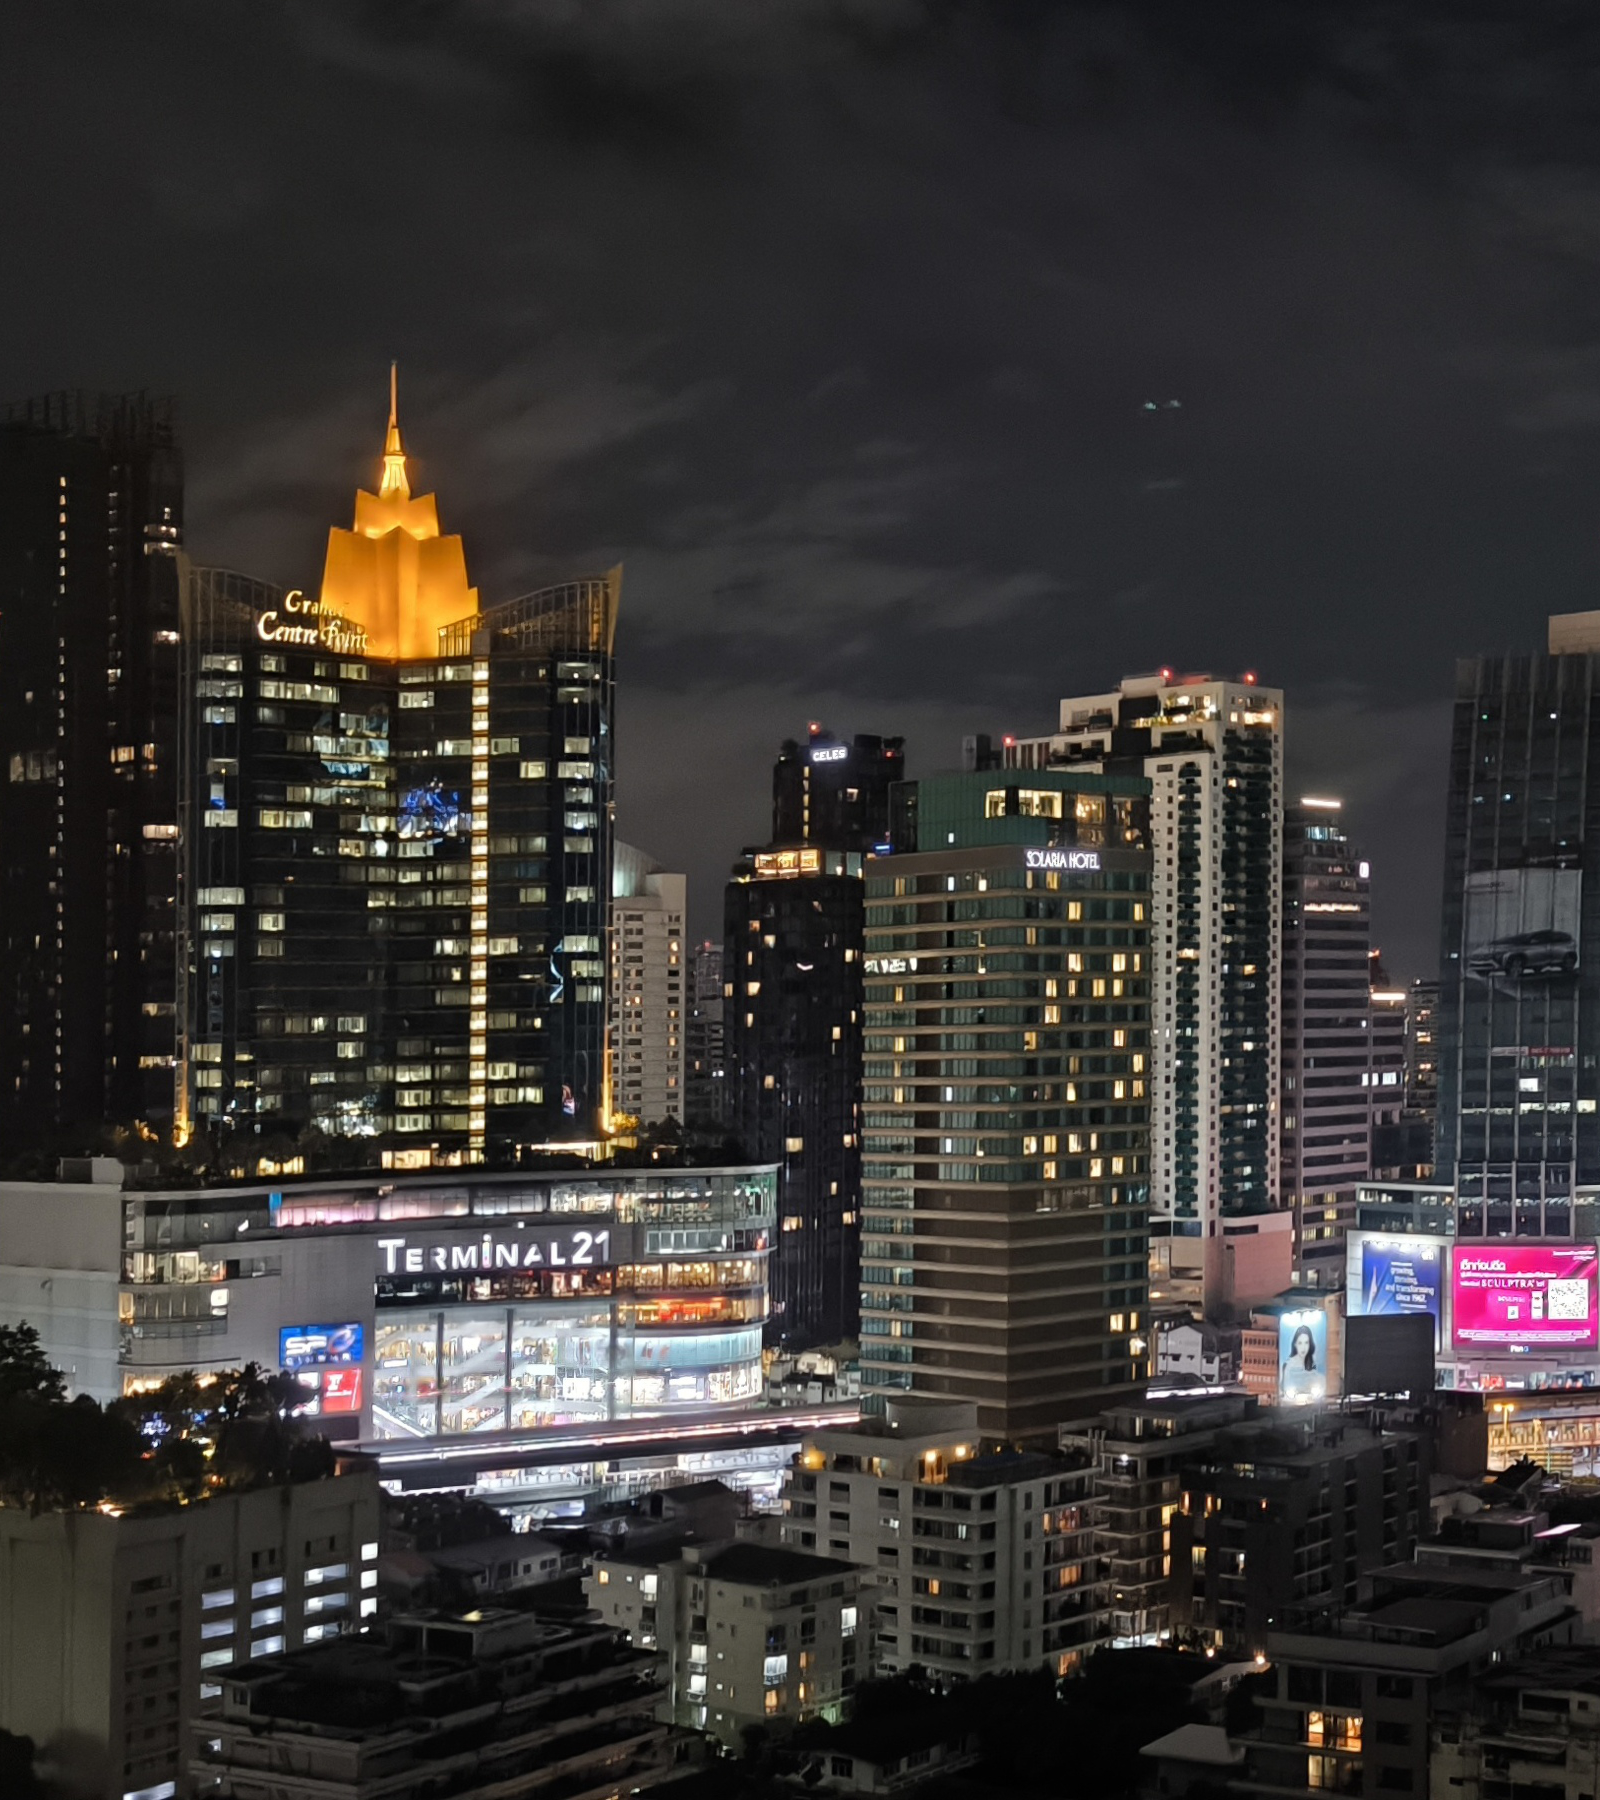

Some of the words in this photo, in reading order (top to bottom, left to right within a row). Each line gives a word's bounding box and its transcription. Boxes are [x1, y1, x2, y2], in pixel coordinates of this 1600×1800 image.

[257, 611, 318, 644] Centre
[320, 620, 369, 650] Point
[813, 749, 846, 762] CELES
[1026, 850, 1067, 868] SOLARIA
[1069, 852, 1101, 870] HOTEL
[377, 1233, 566, 1274] TERMINAL
[571, 1229, 611, 1266] 21
